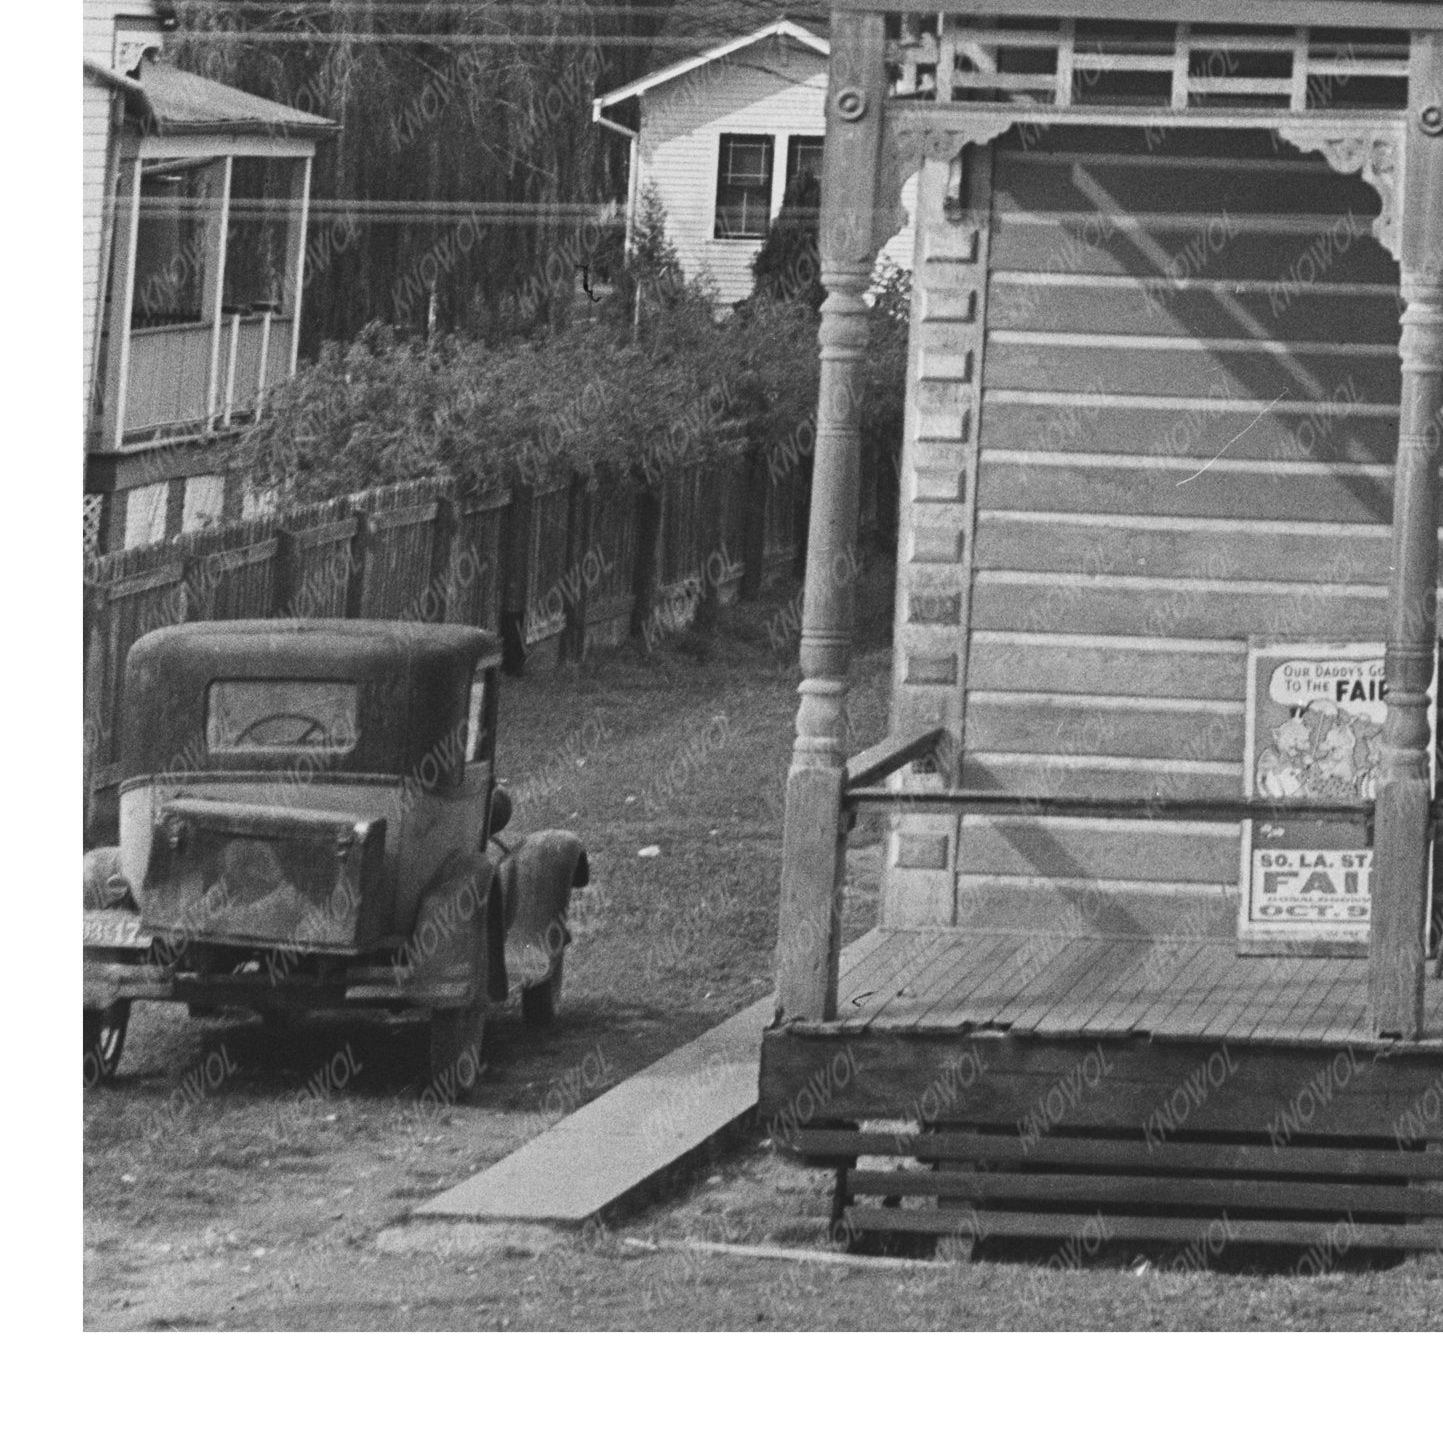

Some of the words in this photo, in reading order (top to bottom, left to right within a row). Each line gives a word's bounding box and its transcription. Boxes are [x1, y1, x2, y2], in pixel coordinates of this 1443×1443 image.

[1284, 665, 1310, 677] OUR
[1286, 679, 1301, 692] TO
[1307, 679, 1330, 692] THE
[1261, 853, 1293, 868] SO.
[1299, 853, 1334, 868] LA.
[1259, 905, 1341, 917] OCT.
